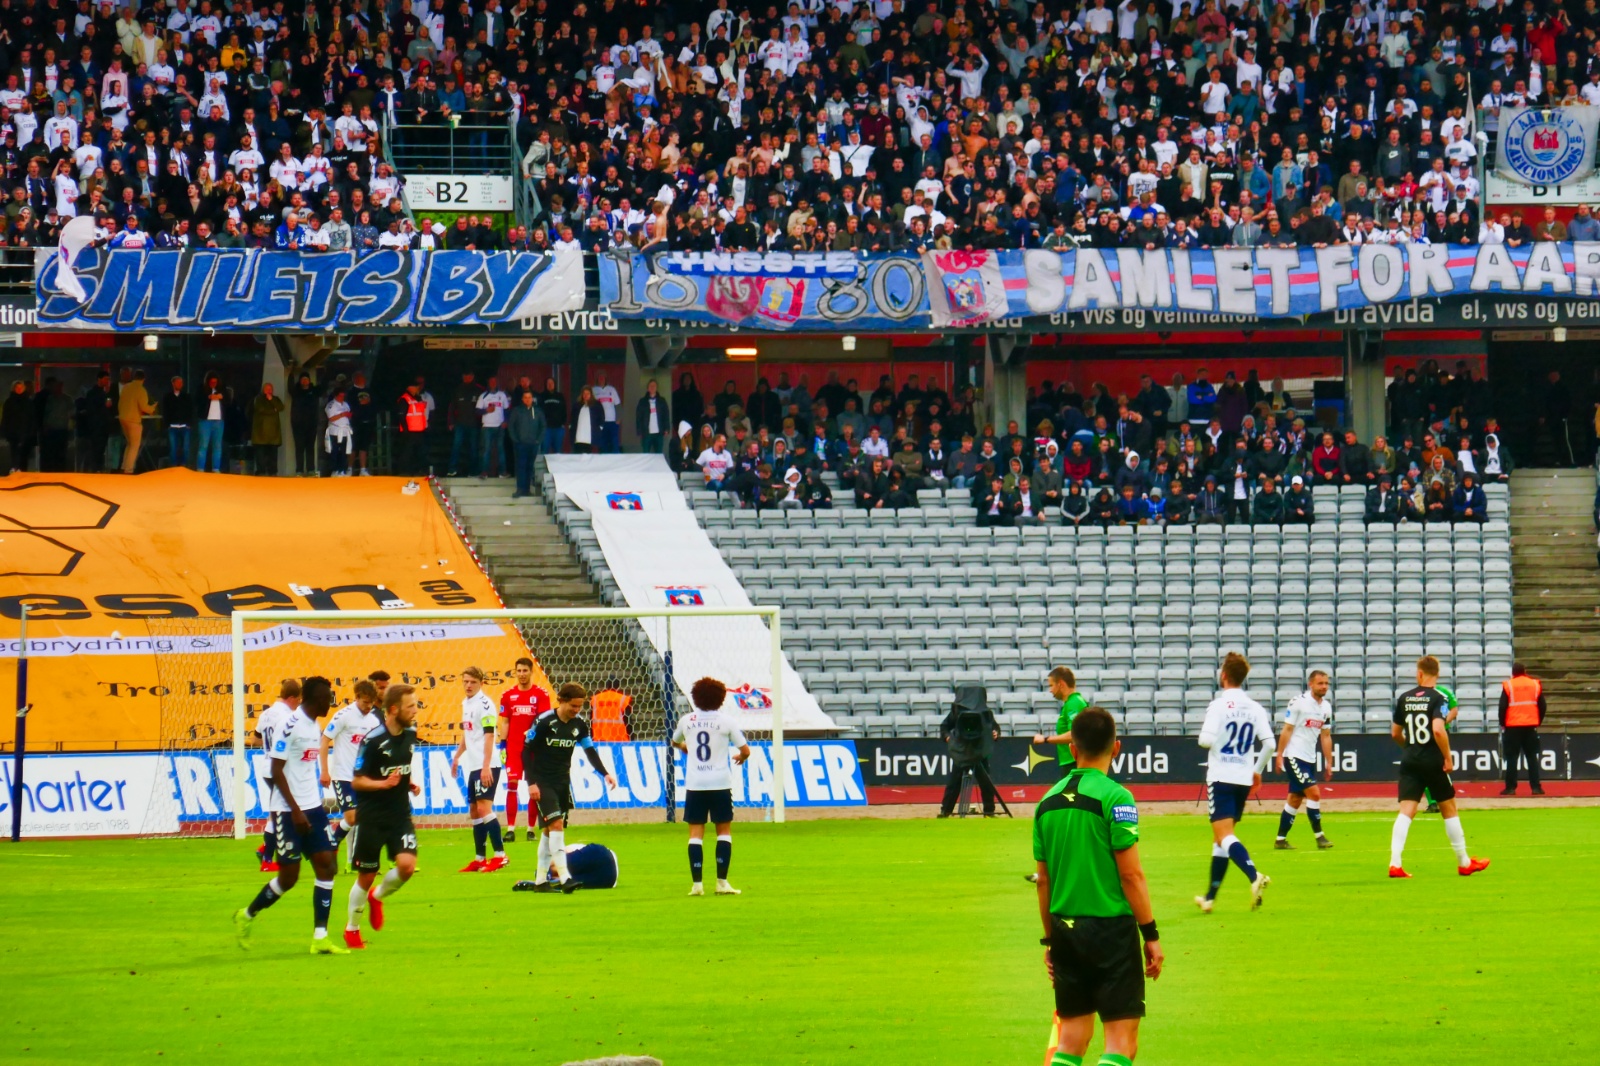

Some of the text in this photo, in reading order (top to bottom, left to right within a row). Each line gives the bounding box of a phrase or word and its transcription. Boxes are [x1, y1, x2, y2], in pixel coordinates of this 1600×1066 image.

[1508, 147, 1582, 181] AFICIONADOS
[436, 181, 469, 203] B2
[415, 249, 550, 322] BY
[816, 256, 926, 322] 80
[1023, 246, 1301, 315] SAMLET
[1315, 243, 1455, 312] FOR
[0, 305, 38, 325] tion
[1082, 309, 1116, 325] vvs
[1121, 308, 1146, 328] og
[1461, 300, 1488, 323] el,
[1494, 302, 1528, 319] vvs
[1534, 302, 1559, 323] og
[1565, 302, 1600, 318] ven
[474, 340, 487, 348] B2
[96, 681, 170, 698] Tro
[398, 670, 517, 691] bjege
[686, 721, 721, 731] AARHUS
[1220, 720, 1254, 756] 20
[1405, 713, 1430, 744] 18
[696, 730, 711, 763] 8
[875, 746, 953, 776] bravi
[1109, 744, 1169, 774] vida
[401, 833, 416, 850] 15
